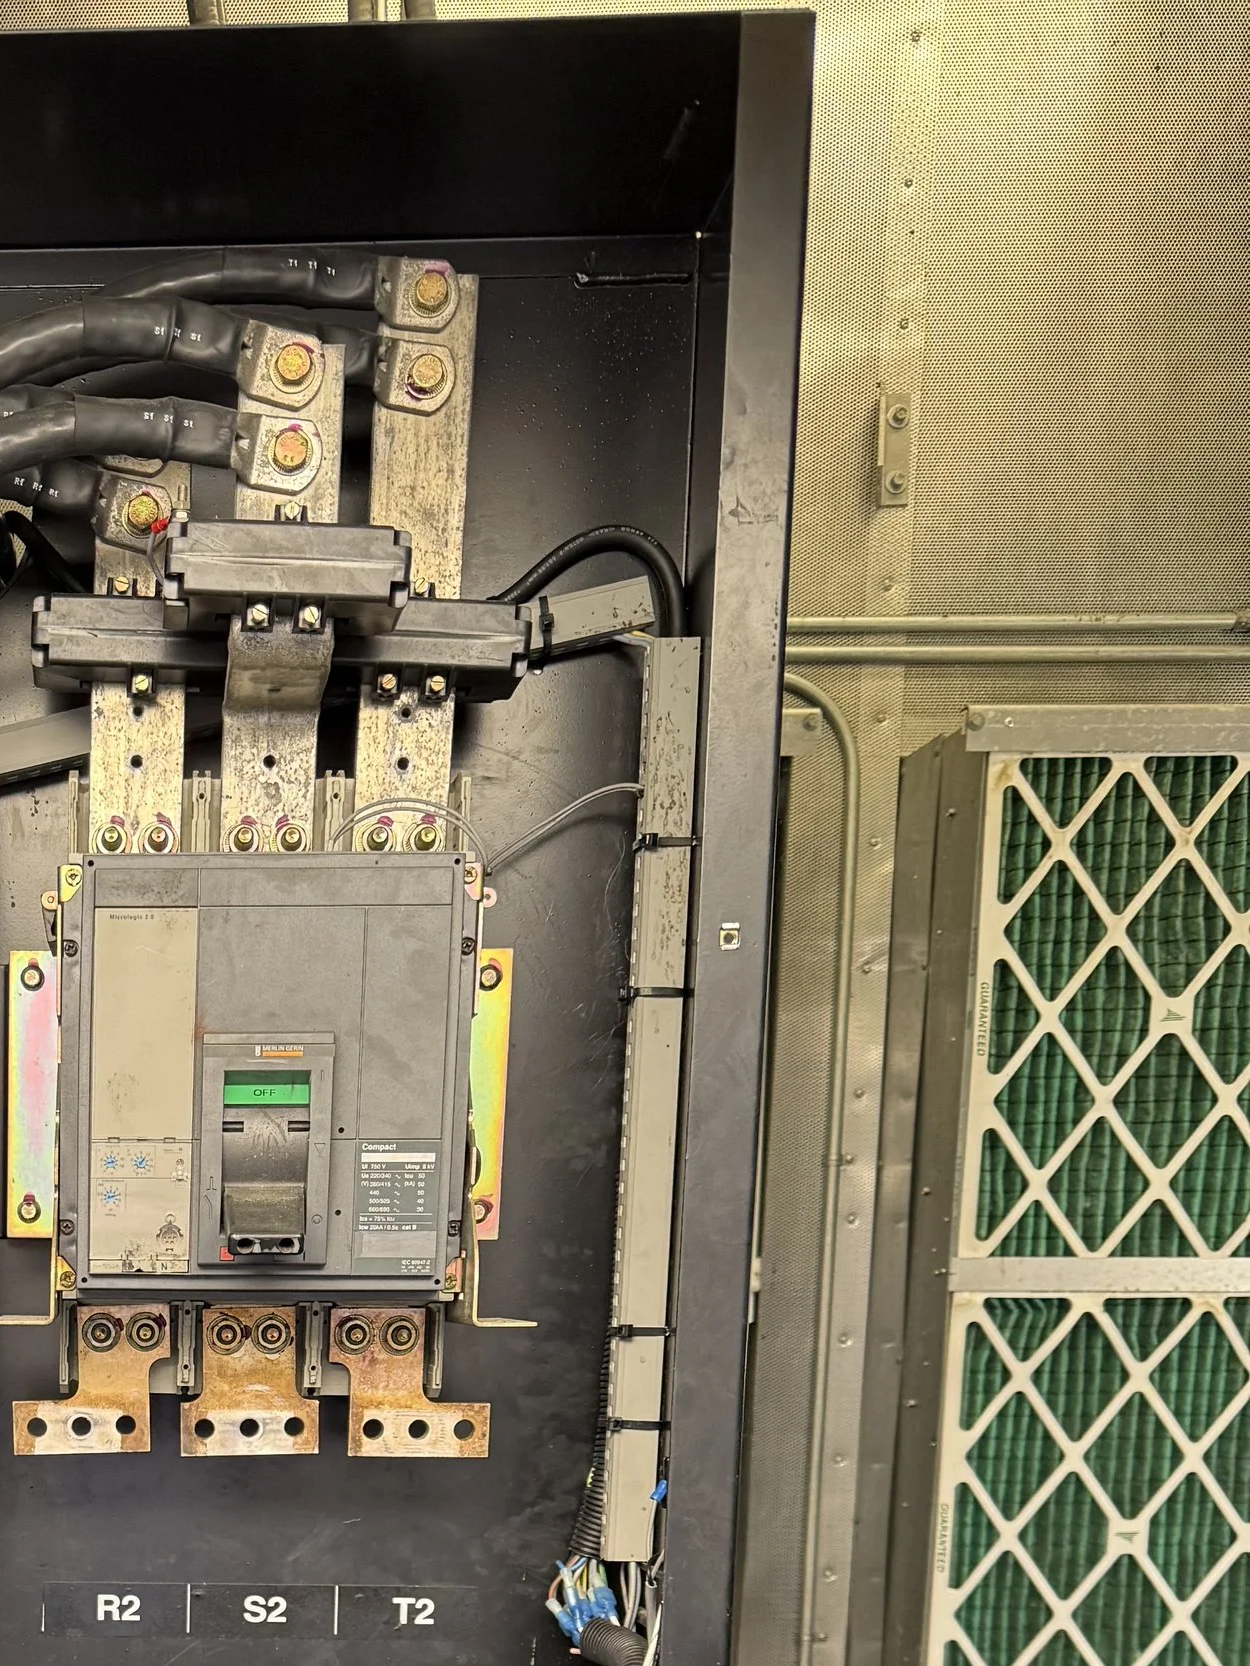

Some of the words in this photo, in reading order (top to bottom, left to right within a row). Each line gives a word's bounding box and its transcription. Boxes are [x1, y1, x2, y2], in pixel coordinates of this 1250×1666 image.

[976, 982, 990, 1056] GUARANTEED
[253, 1089, 276, 1097] OFF
[362, 1143, 397, 1151] Compact
[936, 1503, 950, 1573] GUARANTEED
[97, 1594, 141, 1621] R2
[242, 1595, 287, 1623] S2
[392, 1597, 435, 1625] T2
